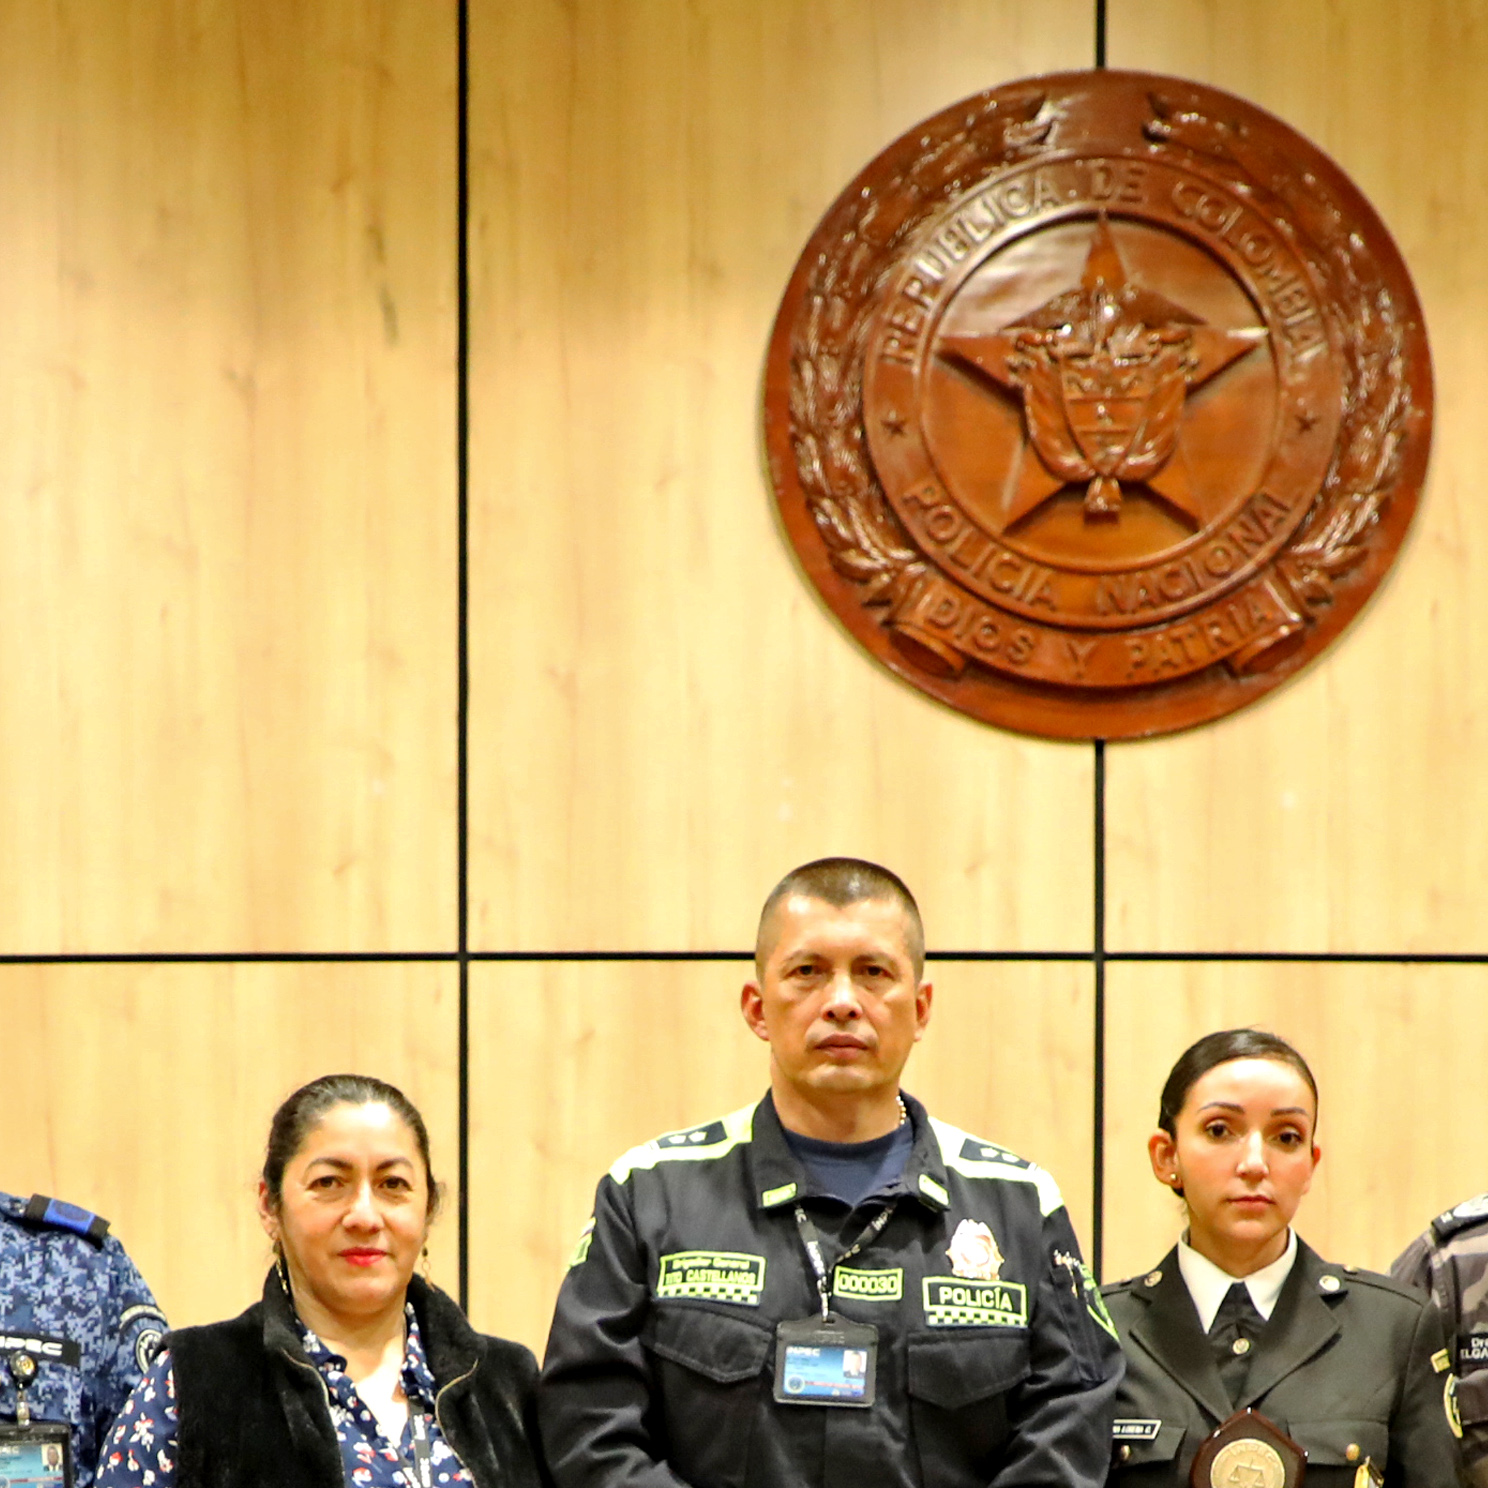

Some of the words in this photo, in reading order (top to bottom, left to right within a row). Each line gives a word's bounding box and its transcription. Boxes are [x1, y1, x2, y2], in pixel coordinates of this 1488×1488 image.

[1090, 158, 1148, 203] DE
[901, 481, 1059, 613] POLICIA
[914, 588, 1036, 666] DIOS
[1065, 638, 1099, 680] Y
[1124, 590, 1276, 682] PATRIA
[838, 1273, 898, 1294] 000030
[939, 1285, 1013, 1311] POLICÍA
